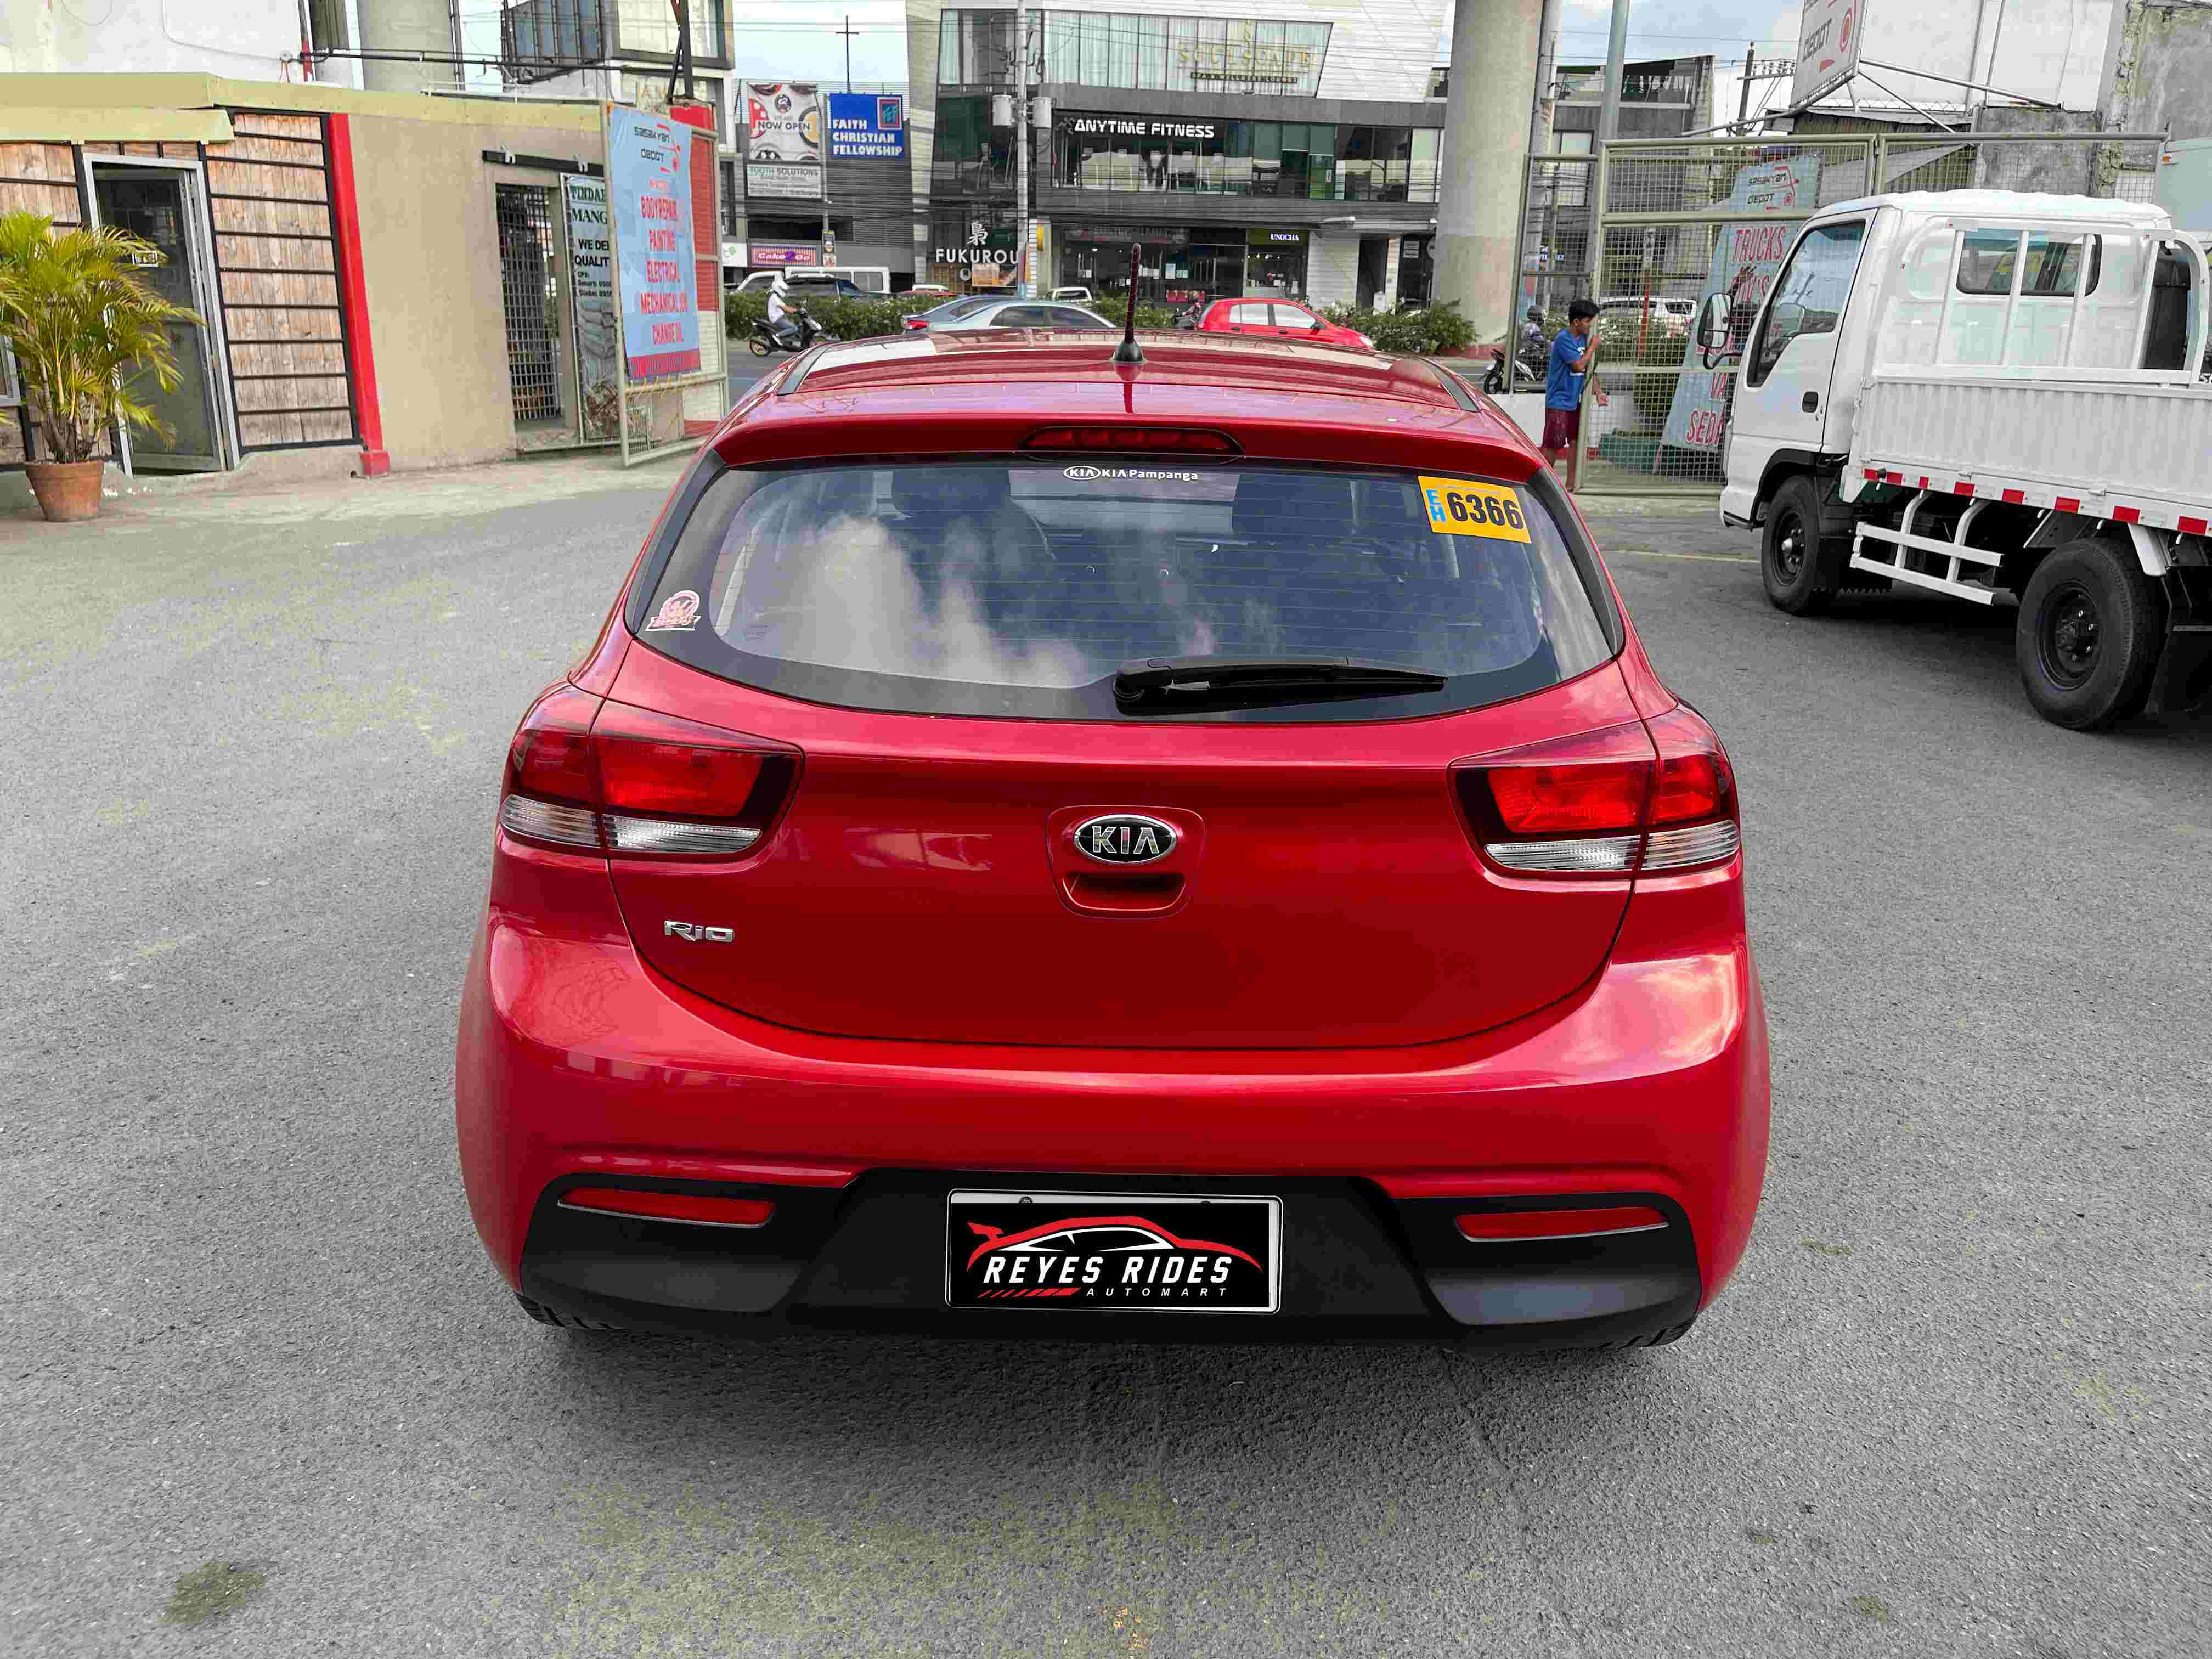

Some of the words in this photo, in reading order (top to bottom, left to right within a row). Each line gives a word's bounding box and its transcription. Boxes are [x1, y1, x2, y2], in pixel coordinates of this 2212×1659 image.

[758, 122, 782, 130] NOW
[785, 122, 810, 131] OPEN
[833, 119, 867, 129] FAITH
[1075, 119, 1146, 135] ANYTIME
[1152, 123, 1214, 138] FITNESS
[833, 132, 895, 143] CHRISTIAN
[833, 144, 902, 156] FELLOWSHIP
[578, 239, 593, 250] WE
[1733, 225, 1787, 262] TRUCKS
[936, 248, 1019, 264] FUKUROU
[1070, 469, 1094, 477] KIA
[1102, 469, 1127, 477] KIA
[1129, 470, 1198, 481] Pampanga
[1447, 492, 1524, 529] 6366
[1092, 826, 1159, 854] KIA
[983, 1256, 1103, 1283] REYES
[1121, 1256, 1232, 1283] RIDES
[1086, 1287, 1228, 1297] AUTOMART
